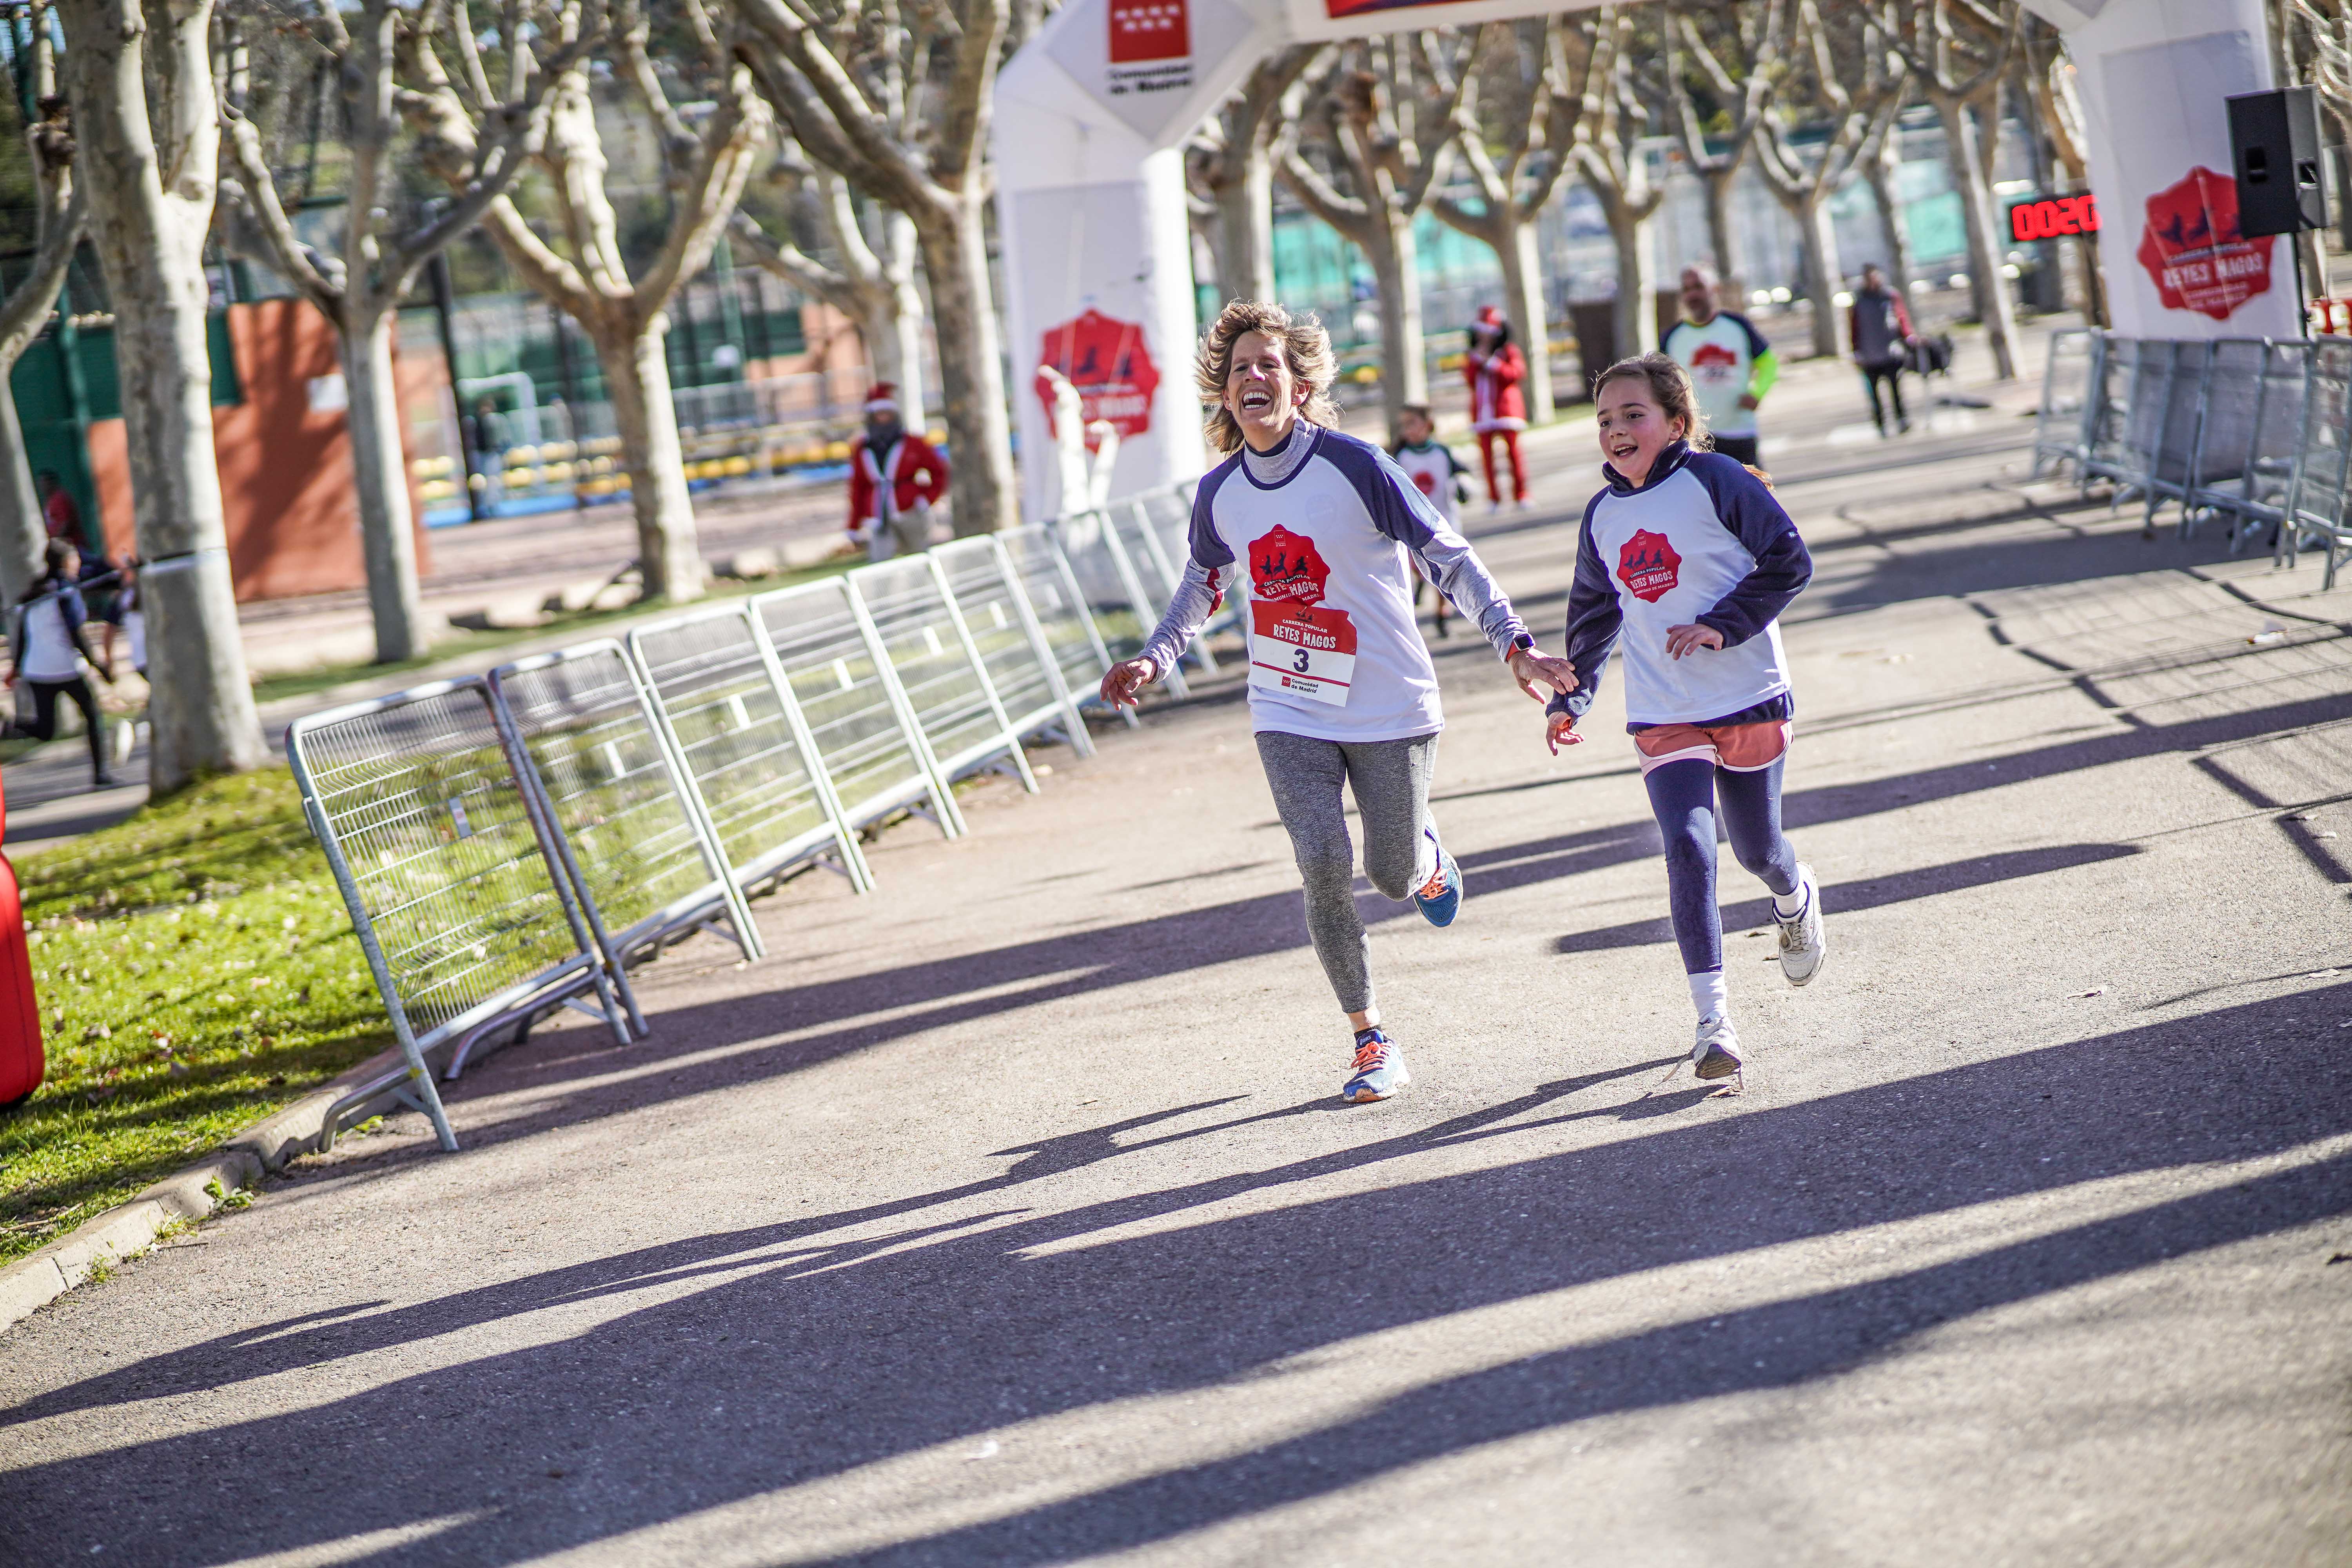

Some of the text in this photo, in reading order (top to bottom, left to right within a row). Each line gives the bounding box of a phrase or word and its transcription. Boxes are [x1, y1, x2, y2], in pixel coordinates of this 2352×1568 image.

[2161, 252, 2263, 288] REYES MAGOS
[1286, 574, 1310, 583] POPULAR
[1630, 571, 1673, 589] REYES MAGOS
[1263, 581, 1319, 595] REYE MAGOS
[1274, 624, 1336, 649] REYES MAGOS
[1305, 624, 1327, 633] POPULAR
[1294, 649, 1309, 672] 3
[1292, 679, 1319, 688] Comunidad
